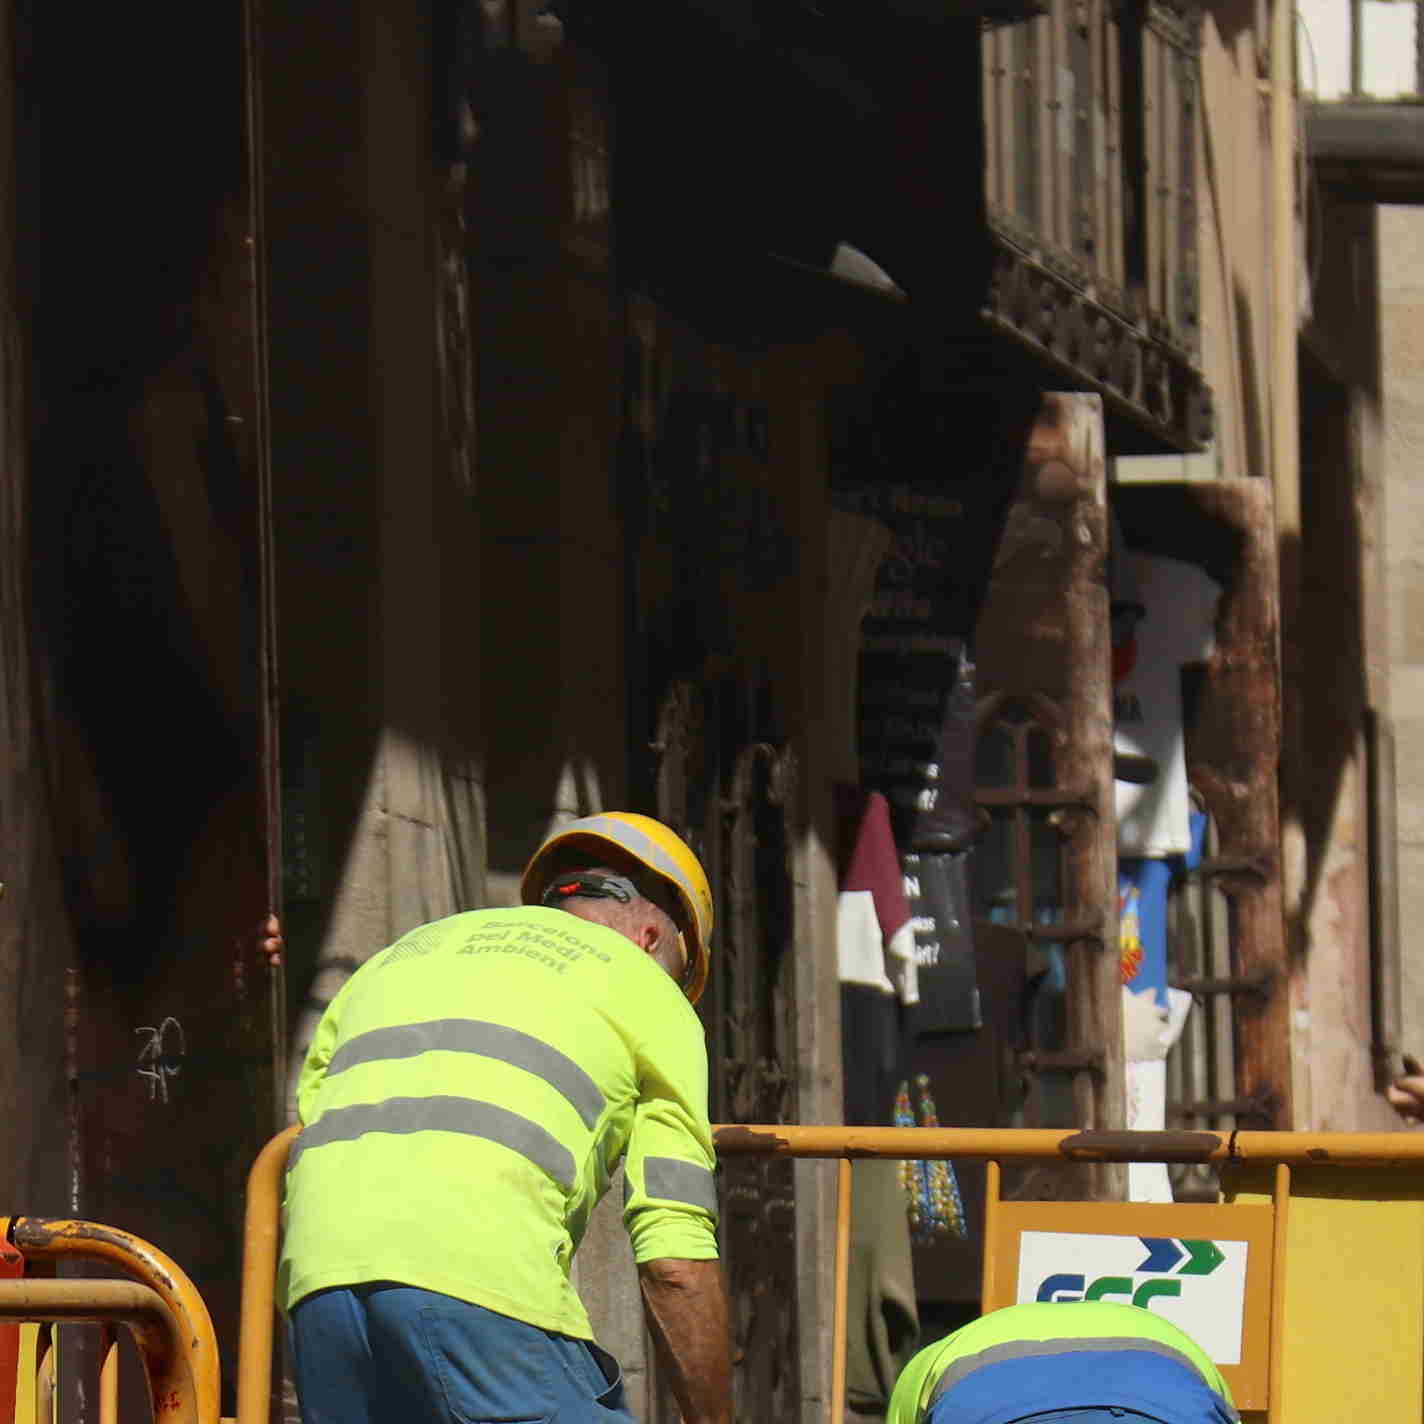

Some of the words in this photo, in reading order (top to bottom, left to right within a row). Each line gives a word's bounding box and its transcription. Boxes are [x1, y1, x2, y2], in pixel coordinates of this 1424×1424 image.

[465, 930, 512, 943] pel
[515, 931, 584, 961] Medi
[480, 920, 612, 964] Barcelona
[456, 943, 568, 976] Ambient
